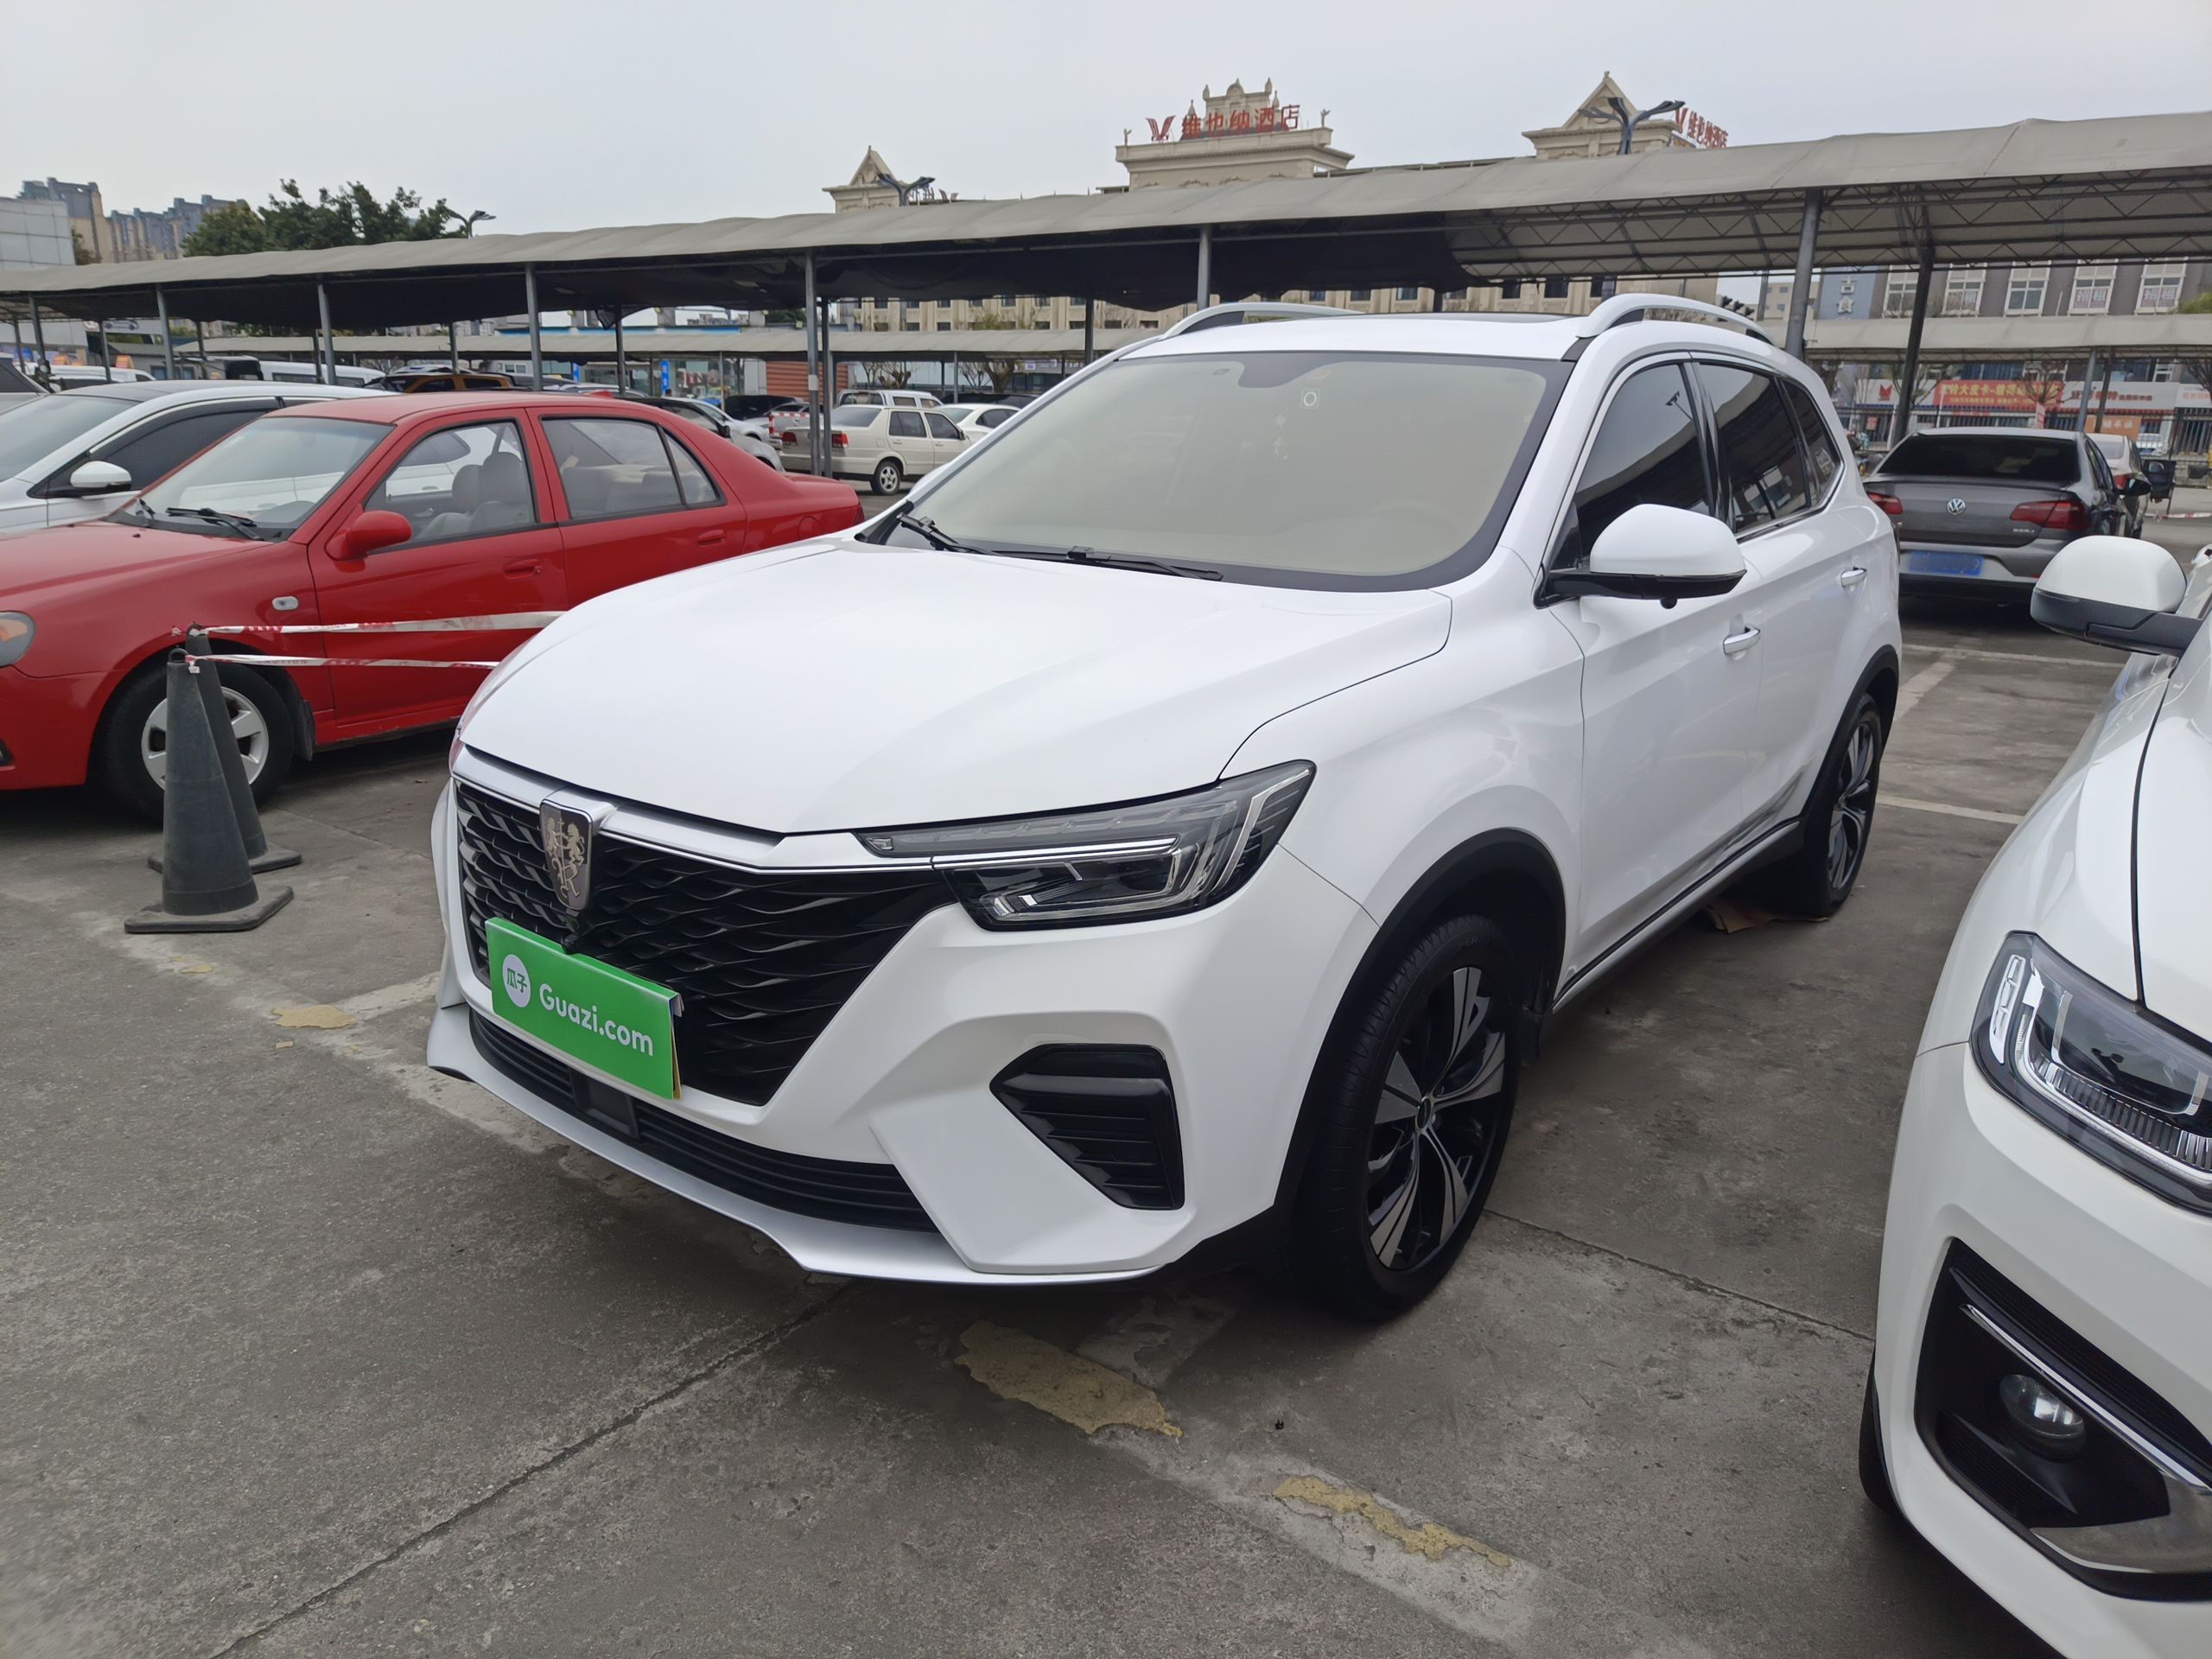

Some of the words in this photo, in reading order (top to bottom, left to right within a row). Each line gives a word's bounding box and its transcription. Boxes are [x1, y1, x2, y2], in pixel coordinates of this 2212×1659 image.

[1181, 105, 1300, 137] 维也纳酒店
[507, 968, 527, 993] 瓜子
[539, 983, 654, 1057] Guazi.com
